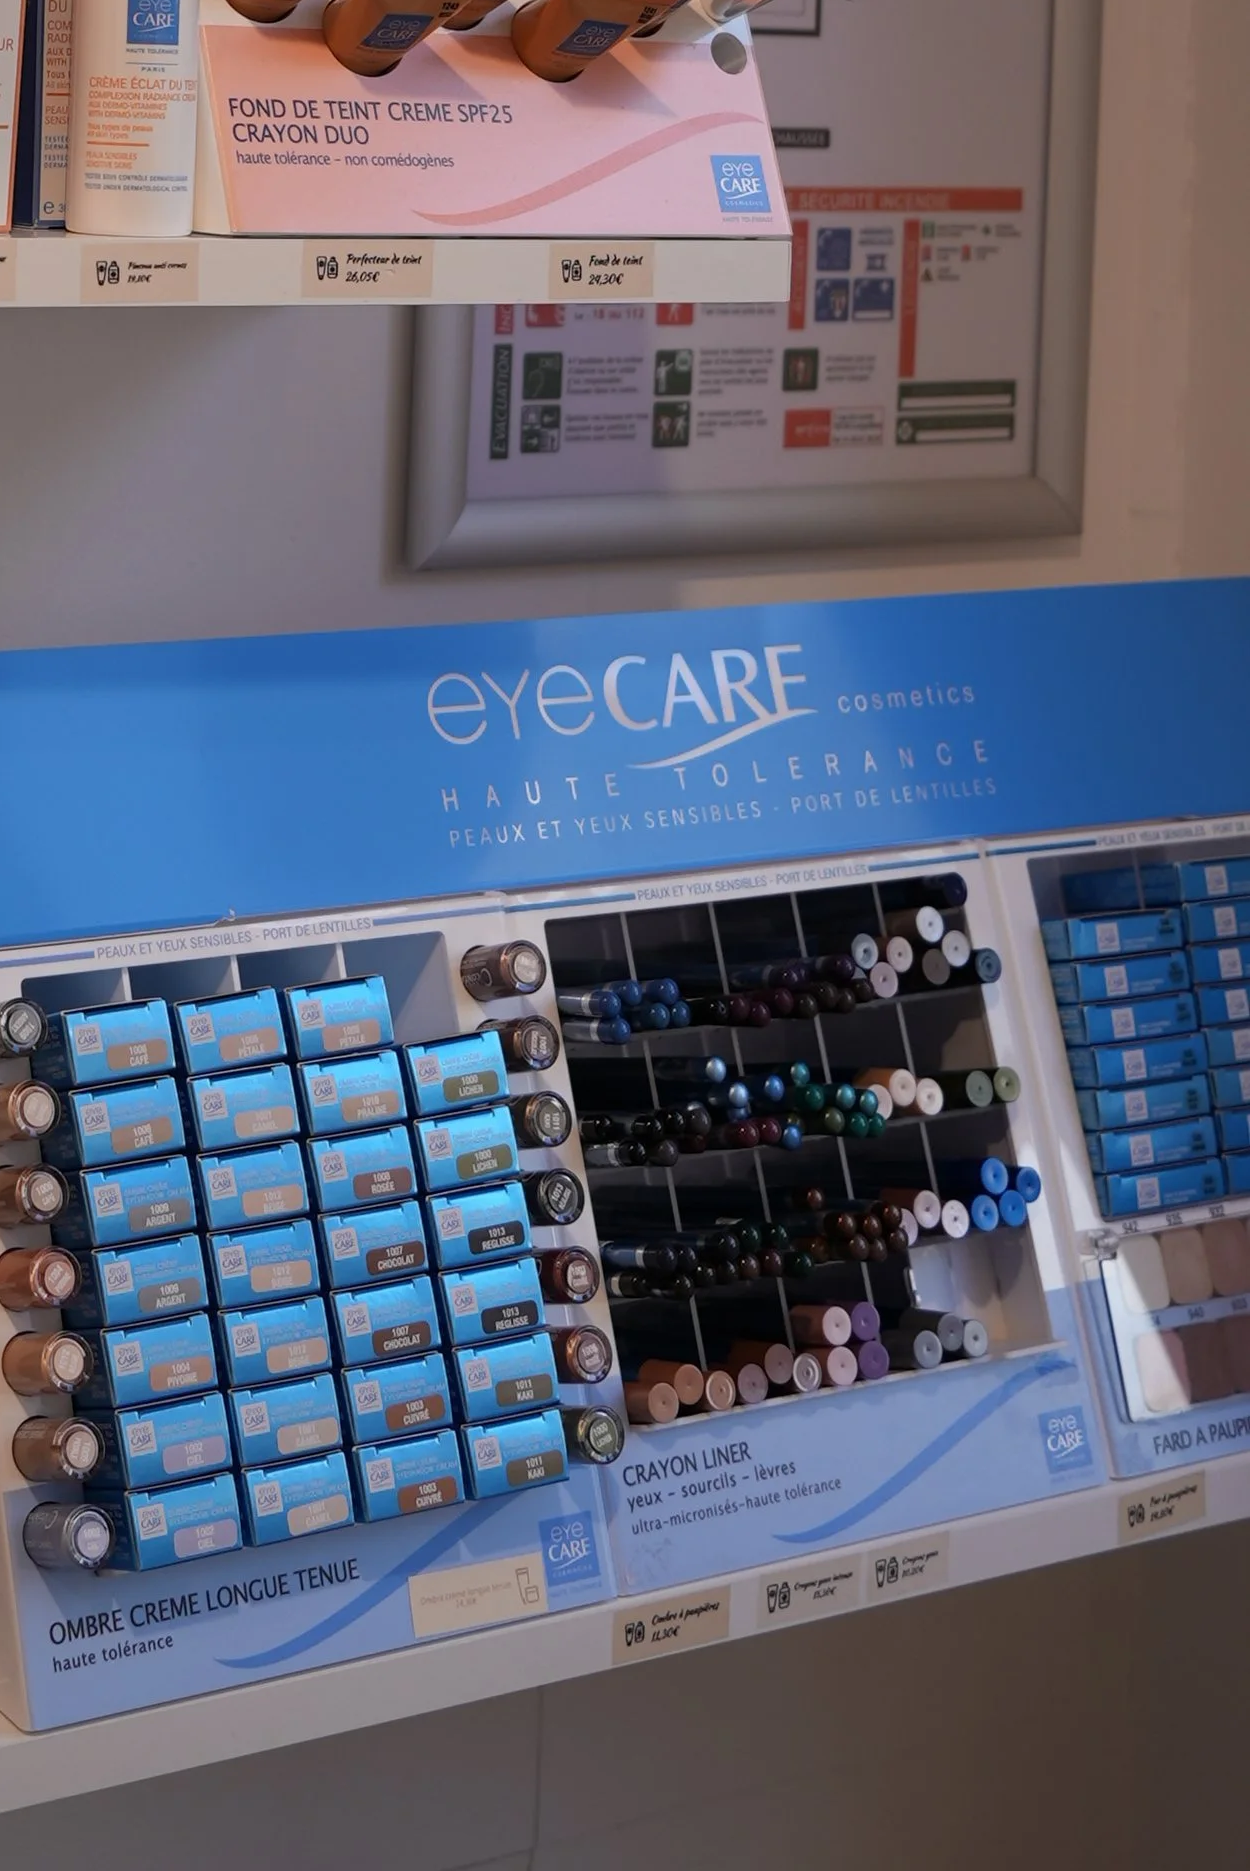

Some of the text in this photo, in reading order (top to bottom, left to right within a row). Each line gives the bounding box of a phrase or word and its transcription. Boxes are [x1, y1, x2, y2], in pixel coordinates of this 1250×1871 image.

[130, 77, 183, 90] ÉCLAT DU
[228, 98, 514, 125] FOND DE TEINT CREME SPF25
[232, 123, 369, 145] CRAYON DUO
[236, 150, 455, 170] haute tolérance non comédogènes
[721, 160, 754, 179] eye
[588, 254, 611, 267] Fond
[345, 270, 380, 285] 26,05€
[427, 644, 816, 753] eyeCARE
[838, 682, 976, 715] cosmetics
[441, 740, 989, 812] HAUTE TOLERANCE
[449, 777, 997, 848] PEAUX ET YEUX SENSIBLES PORT DE LENTILLES
[97, 917, 372, 959] PEAUX ET YEUX SENSIBLES PORT DE LENTILLES
[459, 1083, 484, 1096] LICHEN
[377, 1255, 415, 1270] CHOCOLAT
[1153, 1429, 1192, 1455] FARD
[527, 1467, 545, 1479] KAKI
[623, 1441, 751, 1487] CRAYON LINER
[627, 1461, 796, 1514] yeux sourcils lèvres
[784, 1479, 842, 1501] tolérance
[549, 1538, 591, 1562] CARE
[50, 1559, 360, 1645] OMBRE CREME LONGUE TENUE
[53, 1635, 173, 1672] haute tolérance
